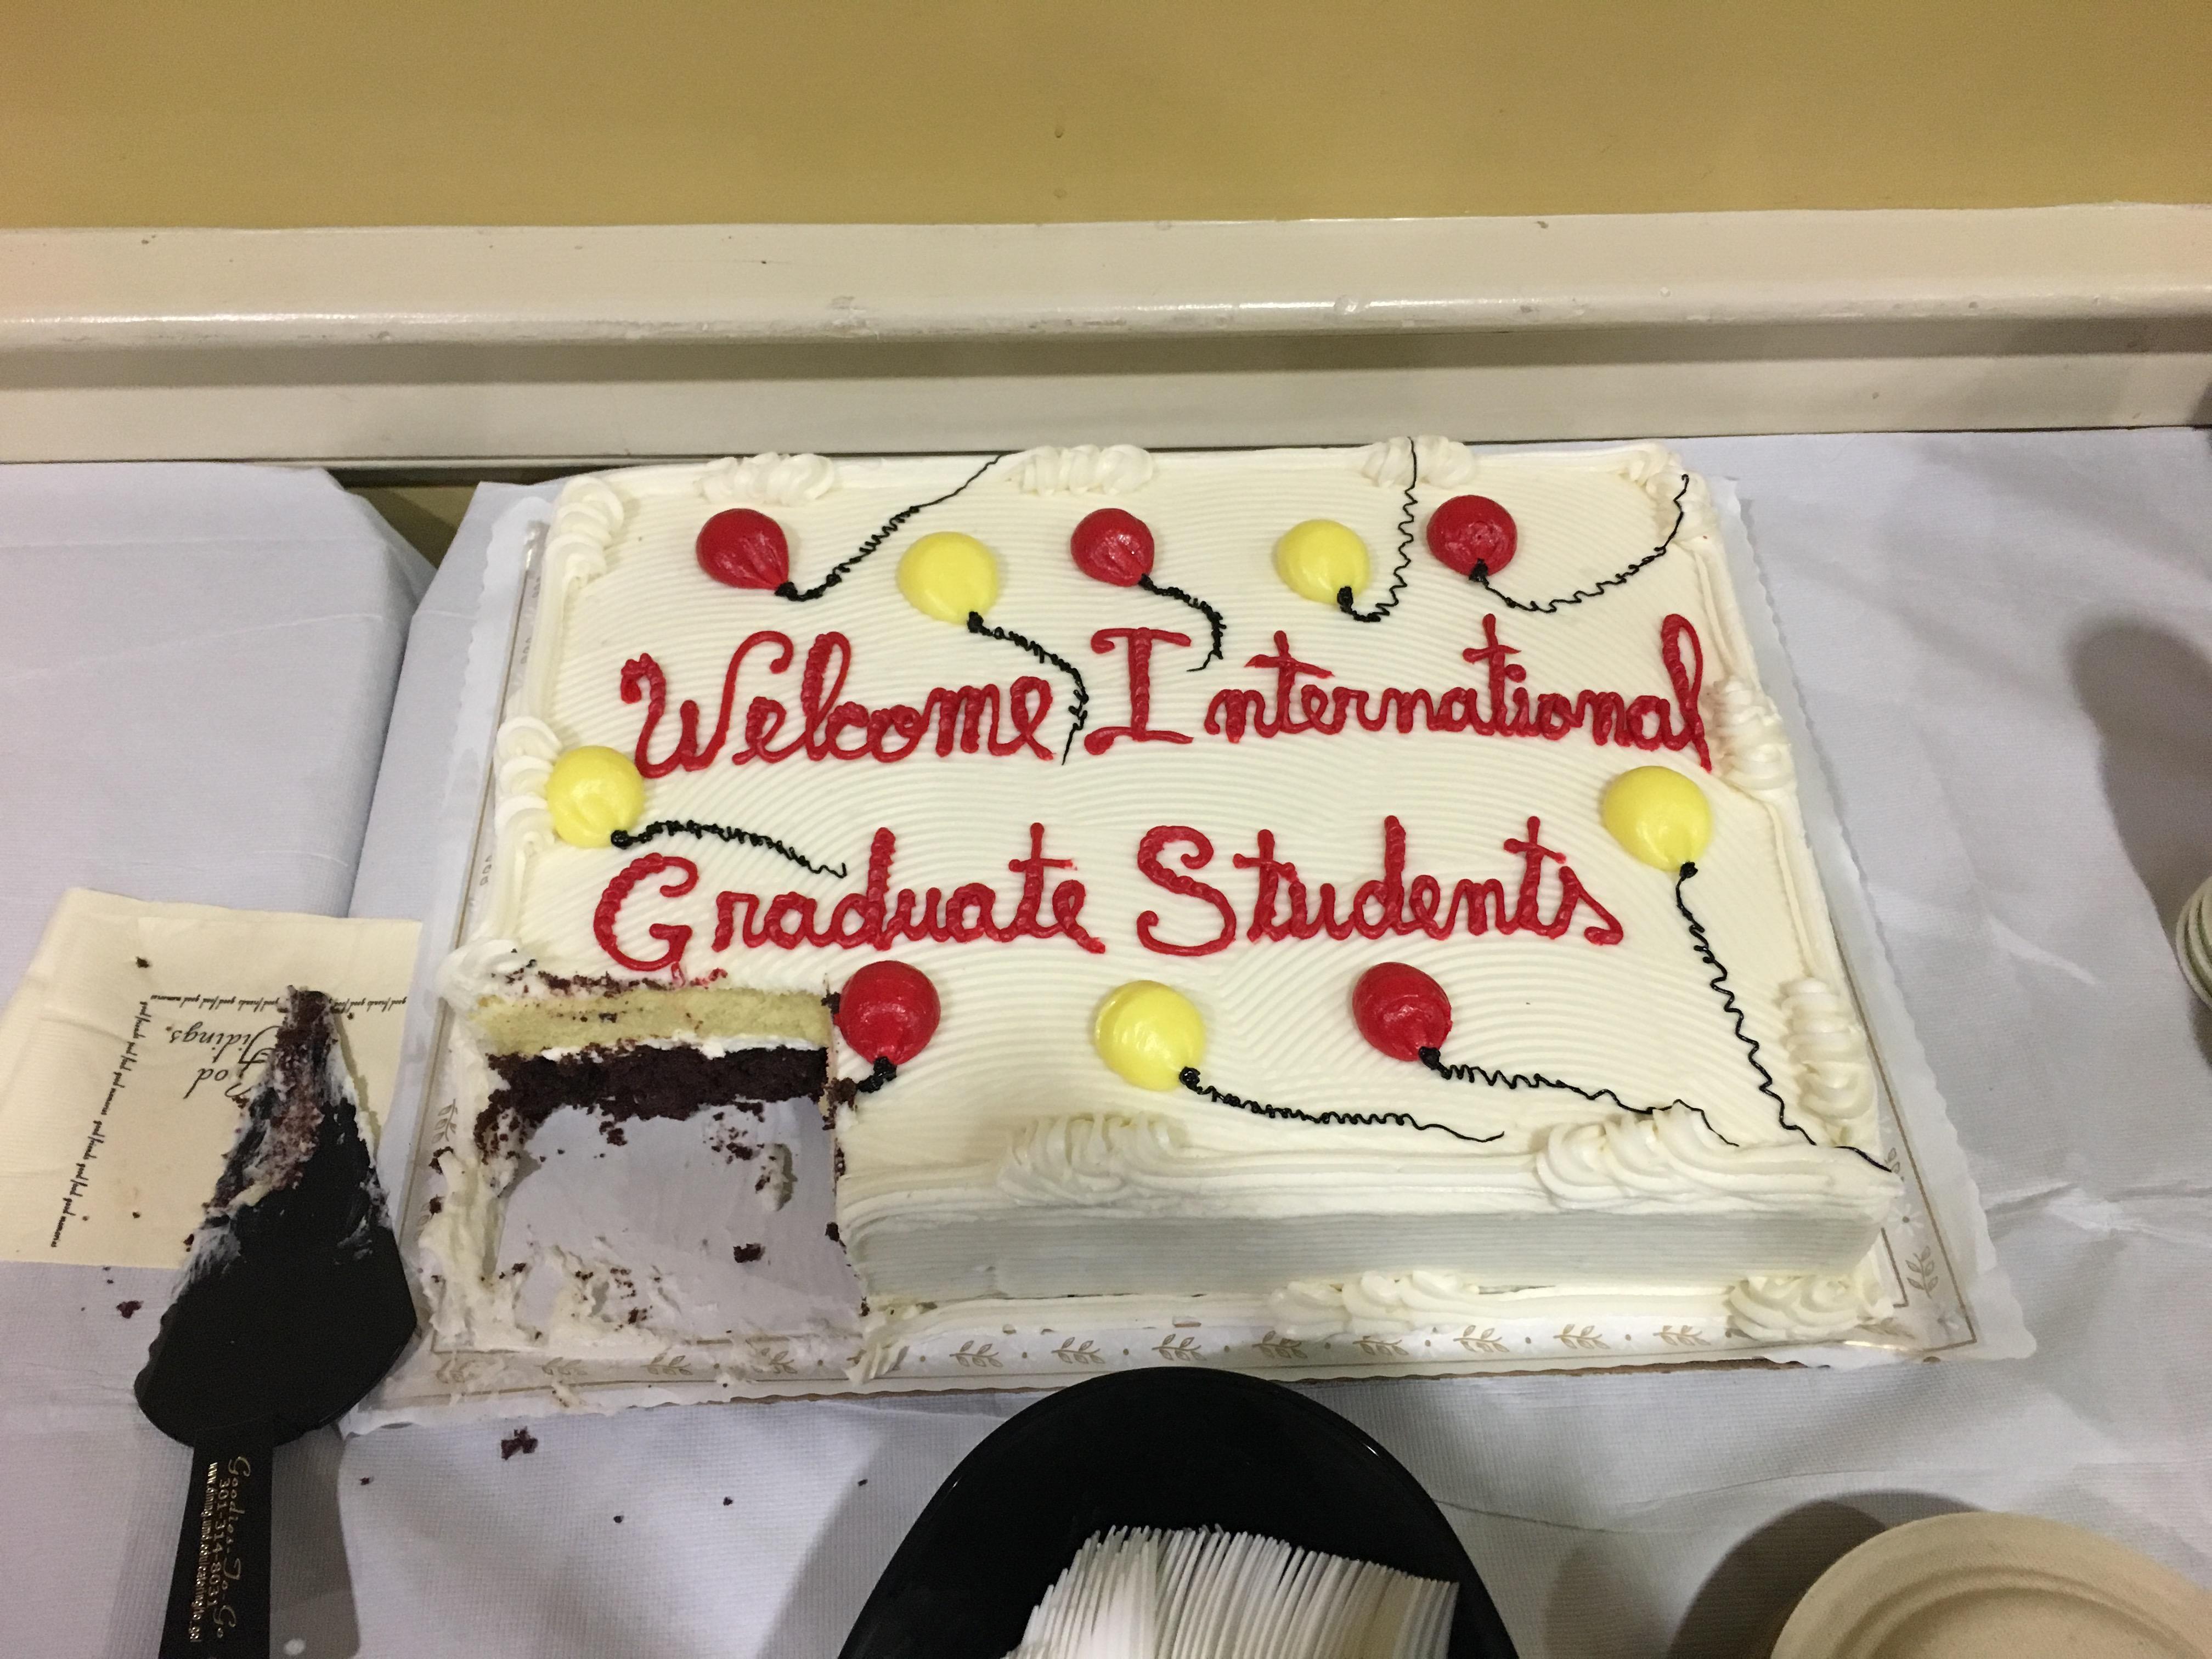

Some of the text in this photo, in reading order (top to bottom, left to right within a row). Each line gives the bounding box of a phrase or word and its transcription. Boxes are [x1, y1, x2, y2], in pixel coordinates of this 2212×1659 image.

[620, 614, 1713, 779] Welcome International
[594, 815, 1624, 971] Graduate Students
[169, 1021, 281, 1063] Tidings
